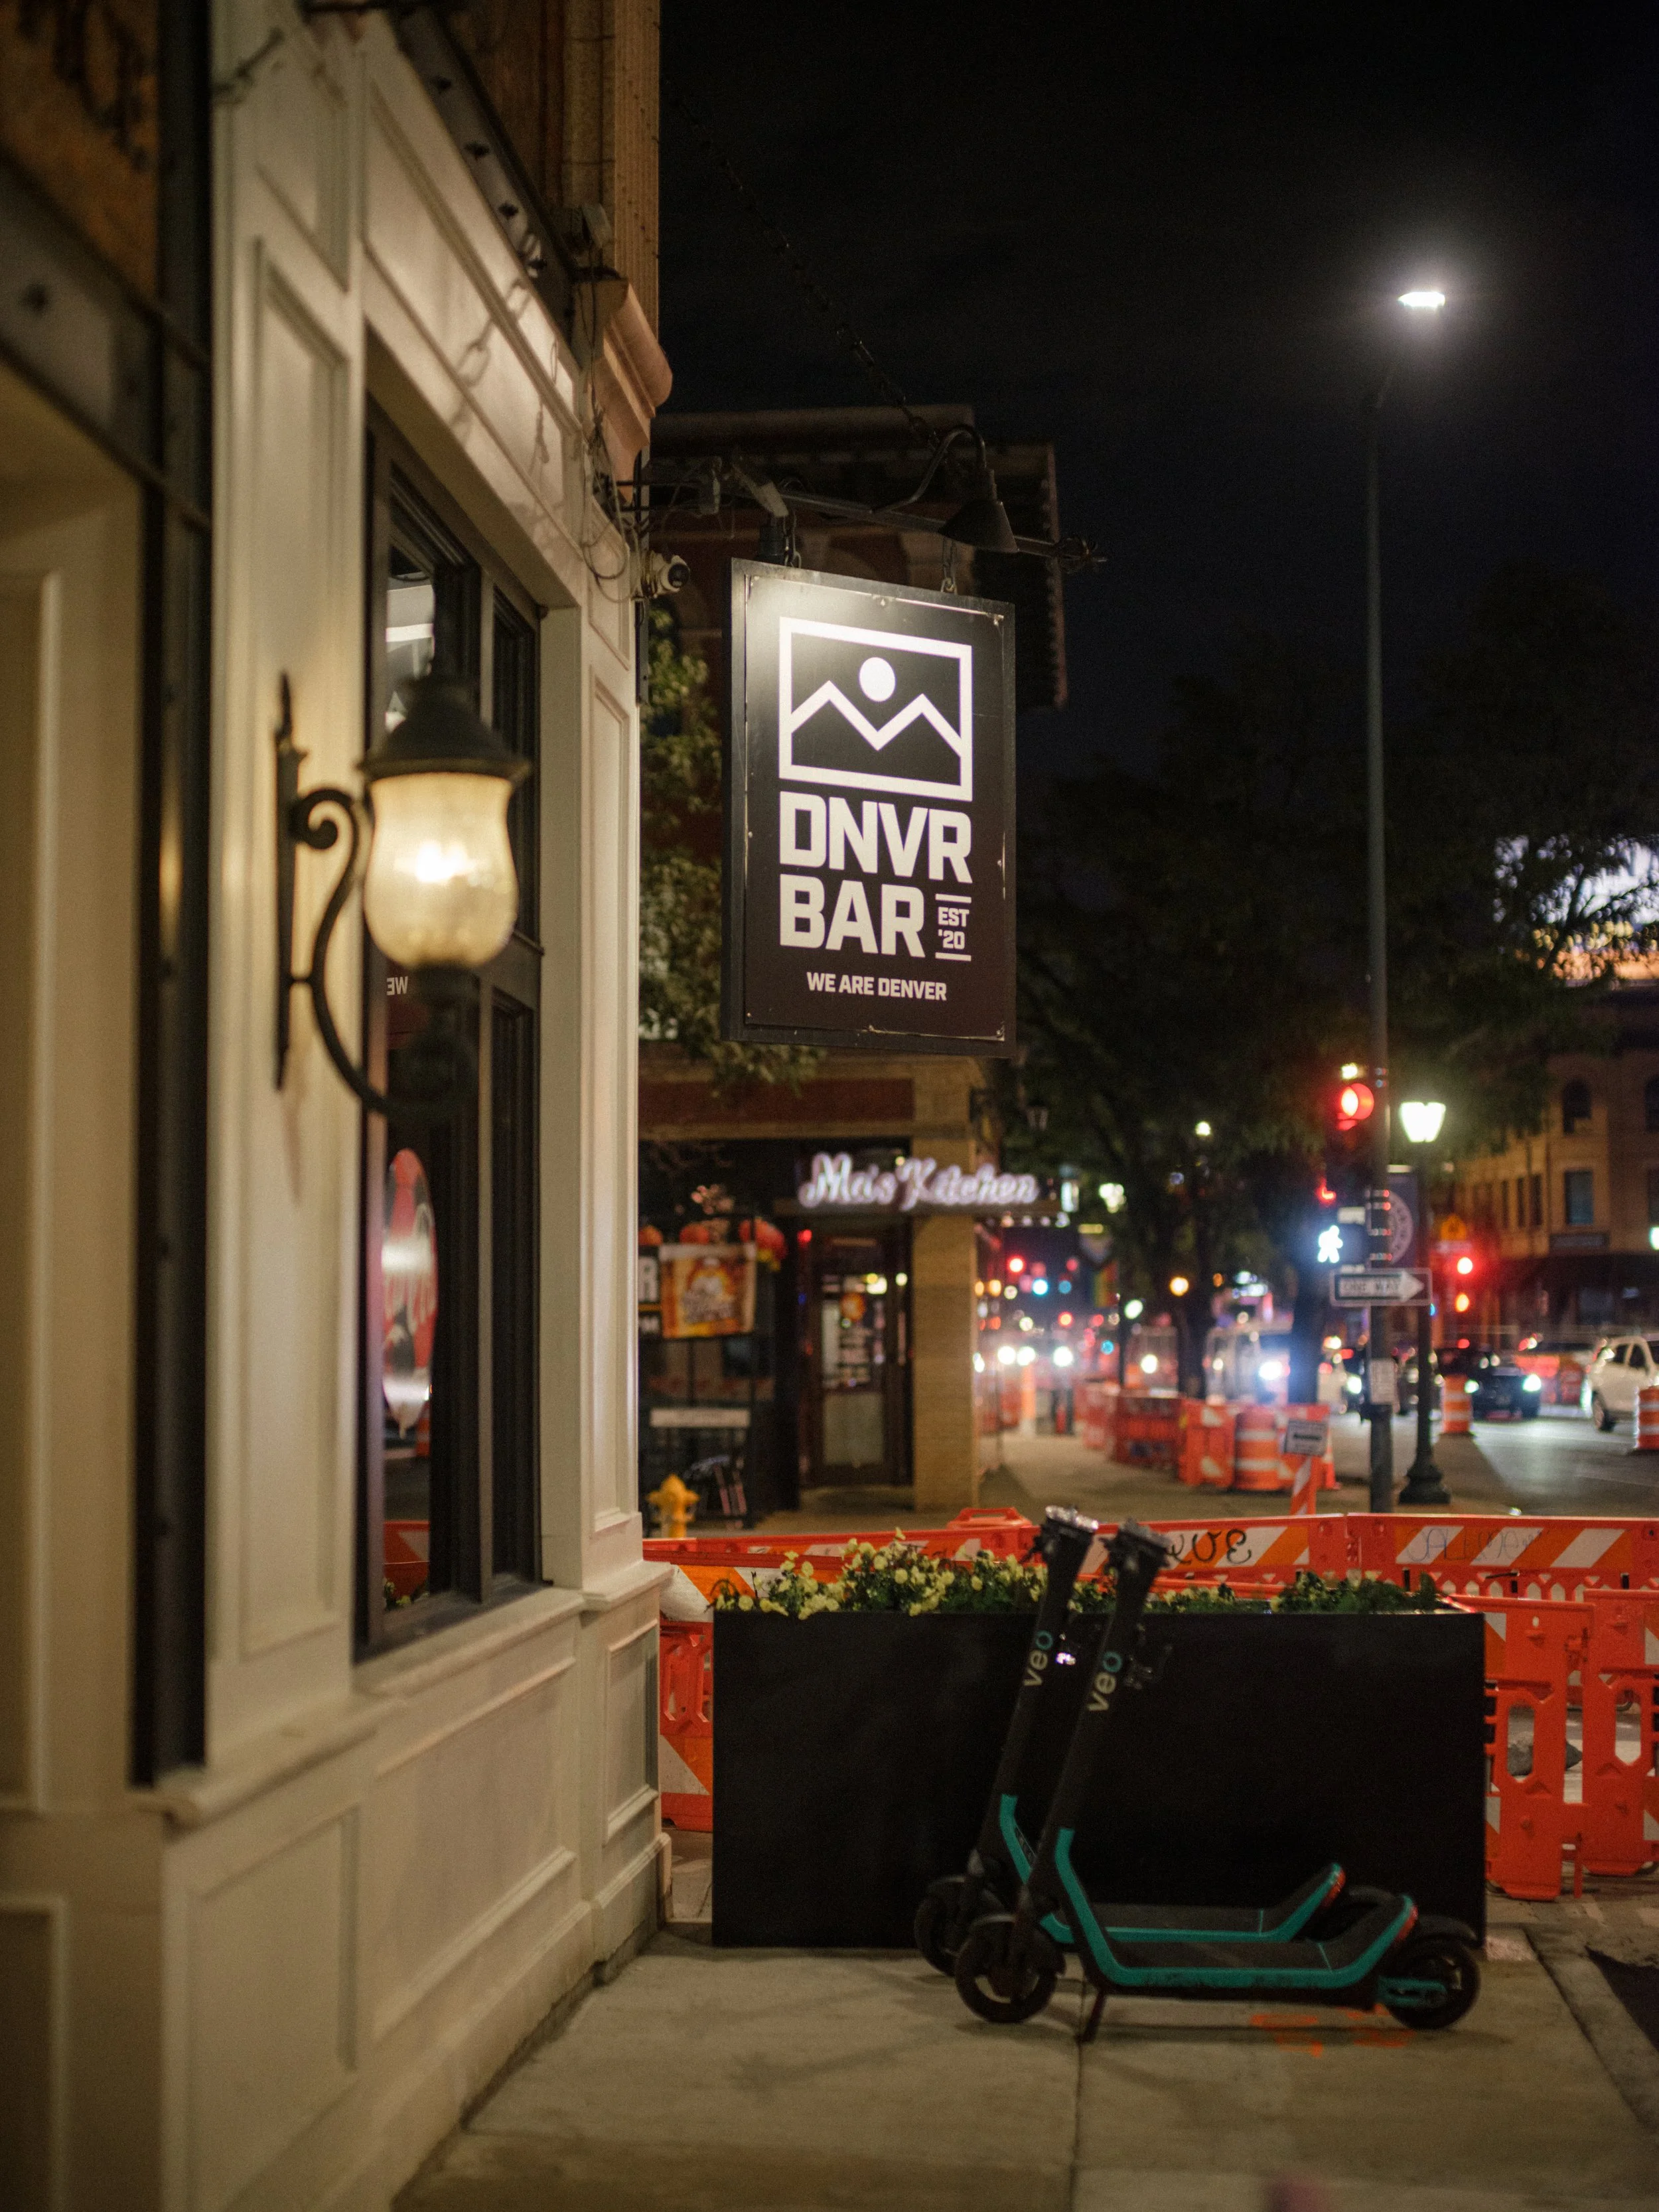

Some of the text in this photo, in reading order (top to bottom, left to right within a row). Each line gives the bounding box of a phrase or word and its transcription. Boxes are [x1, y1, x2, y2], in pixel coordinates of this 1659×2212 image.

[779, 791, 973, 883] DNVR
[779, 874, 926, 958] BAR
[938, 907, 970, 927] EST
[938, 929, 966, 950] '20
[806, 972, 948, 1001] WE ARE DENVER
[897, 1157, 1039, 1211] Kitchen
[1023, 1630, 1054, 1686] veo
[1086, 1651, 1123, 1712] veo
